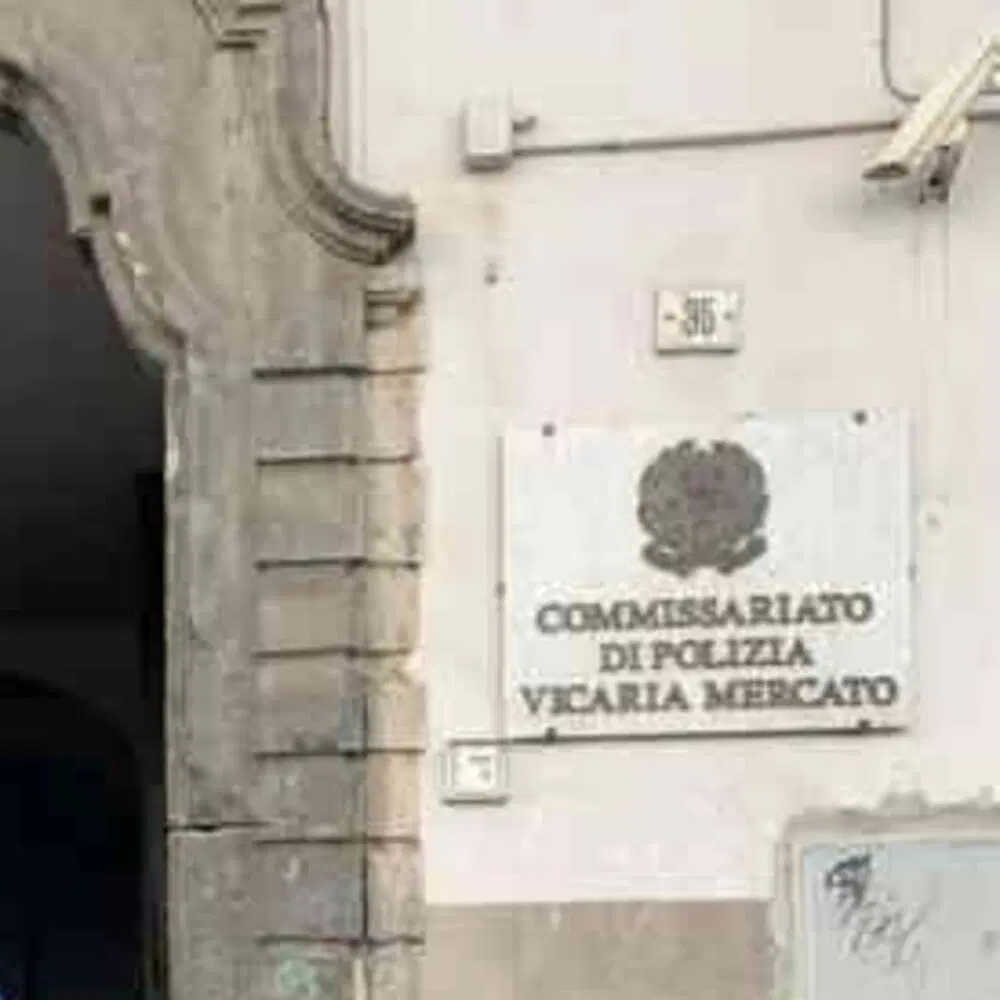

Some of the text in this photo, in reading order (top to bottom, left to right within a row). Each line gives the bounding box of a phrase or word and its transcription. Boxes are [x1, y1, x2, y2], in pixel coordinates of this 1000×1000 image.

[535, 592, 874, 634] COMMISSARIATO
[600, 637, 815, 673] DI POLIZIA
[521, 676, 898, 715] VICARIA MERCATO
